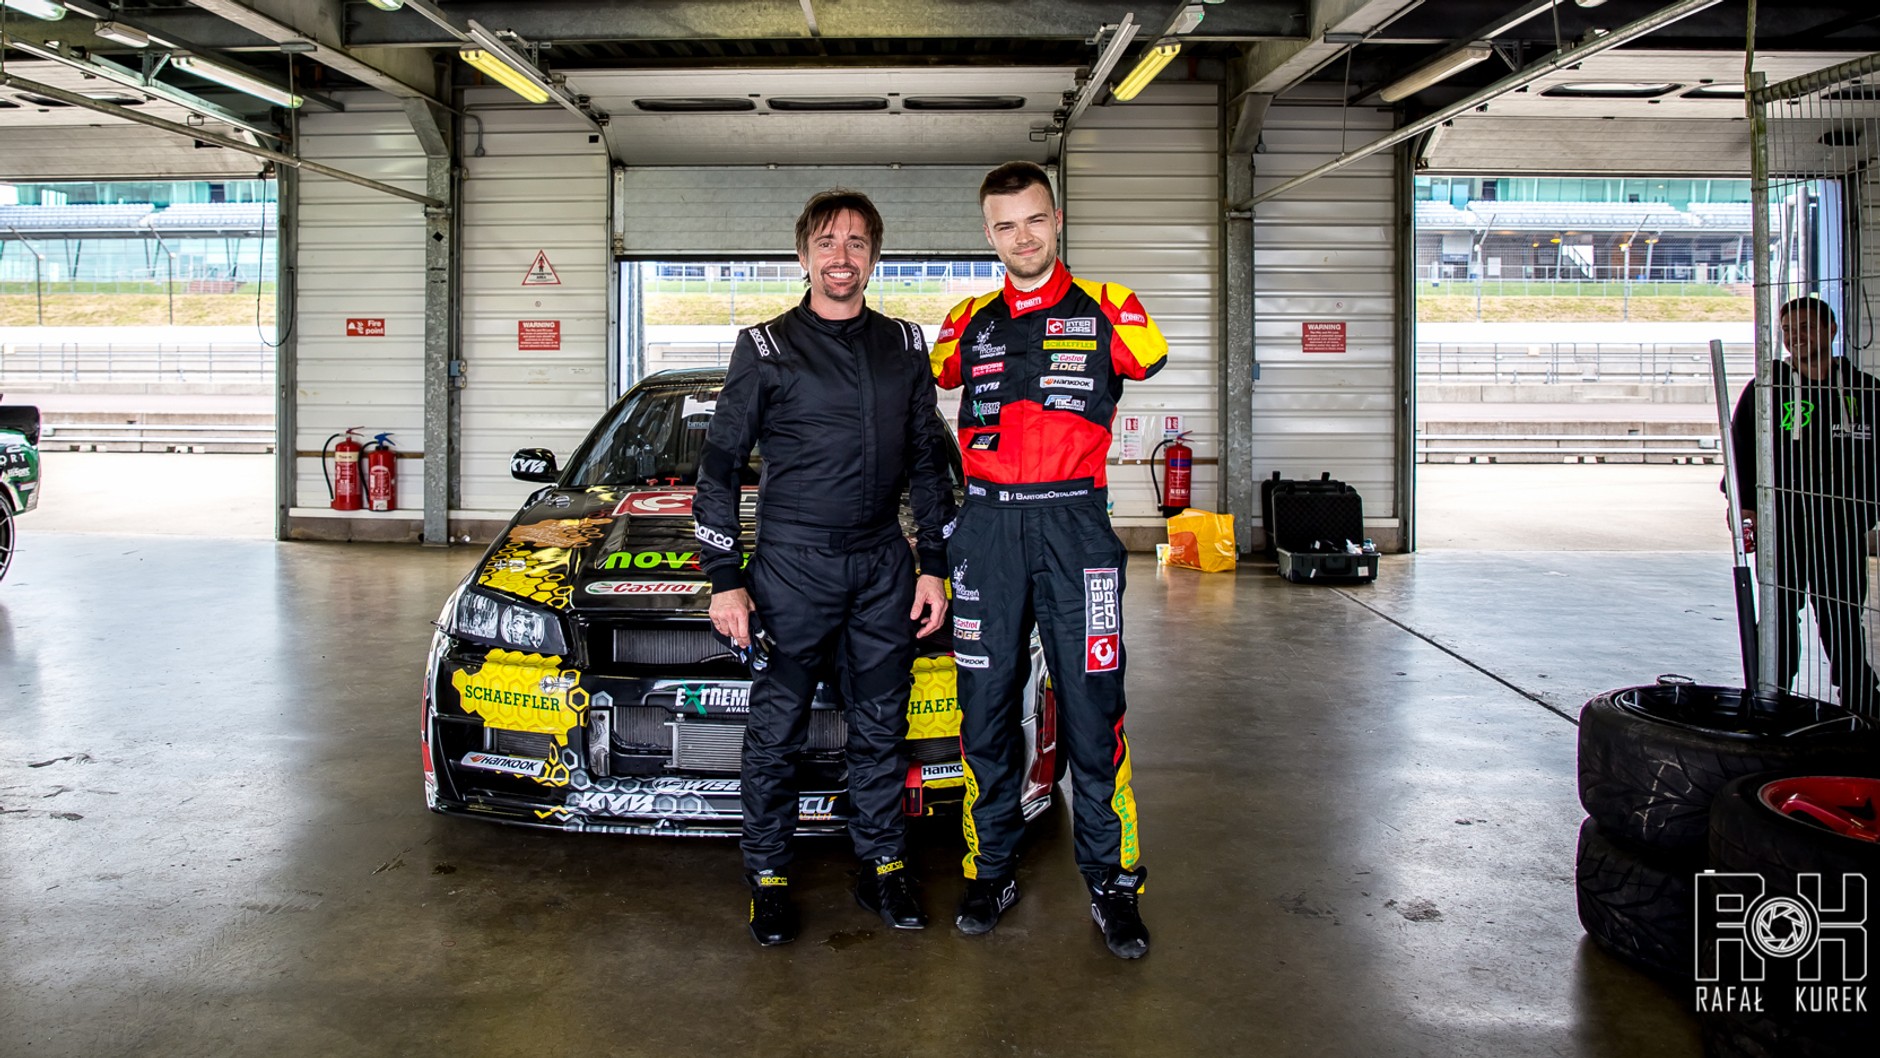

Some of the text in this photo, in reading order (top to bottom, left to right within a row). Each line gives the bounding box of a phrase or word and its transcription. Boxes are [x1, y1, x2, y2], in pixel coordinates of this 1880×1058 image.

[365, 327, 384, 335] point
[1049, 362, 1087, 372] EDGE
[975, 381, 1000, 395] KYB
[511, 458, 548, 473] KYB
[695, 520, 735, 550] arco
[613, 583, 694, 593] Castrol
[1090, 578, 1105, 630] INTER
[1102, 577, 1116, 629] CARS
[465, 684, 560, 712] SCHAEFFLER
[675, 679, 751, 714] EXTREM
[908, 697, 961, 715] HAEF
[683, 779, 742, 791] WISE
[580, 792, 655, 812] KYB
[761, 876, 788, 887] sparc
